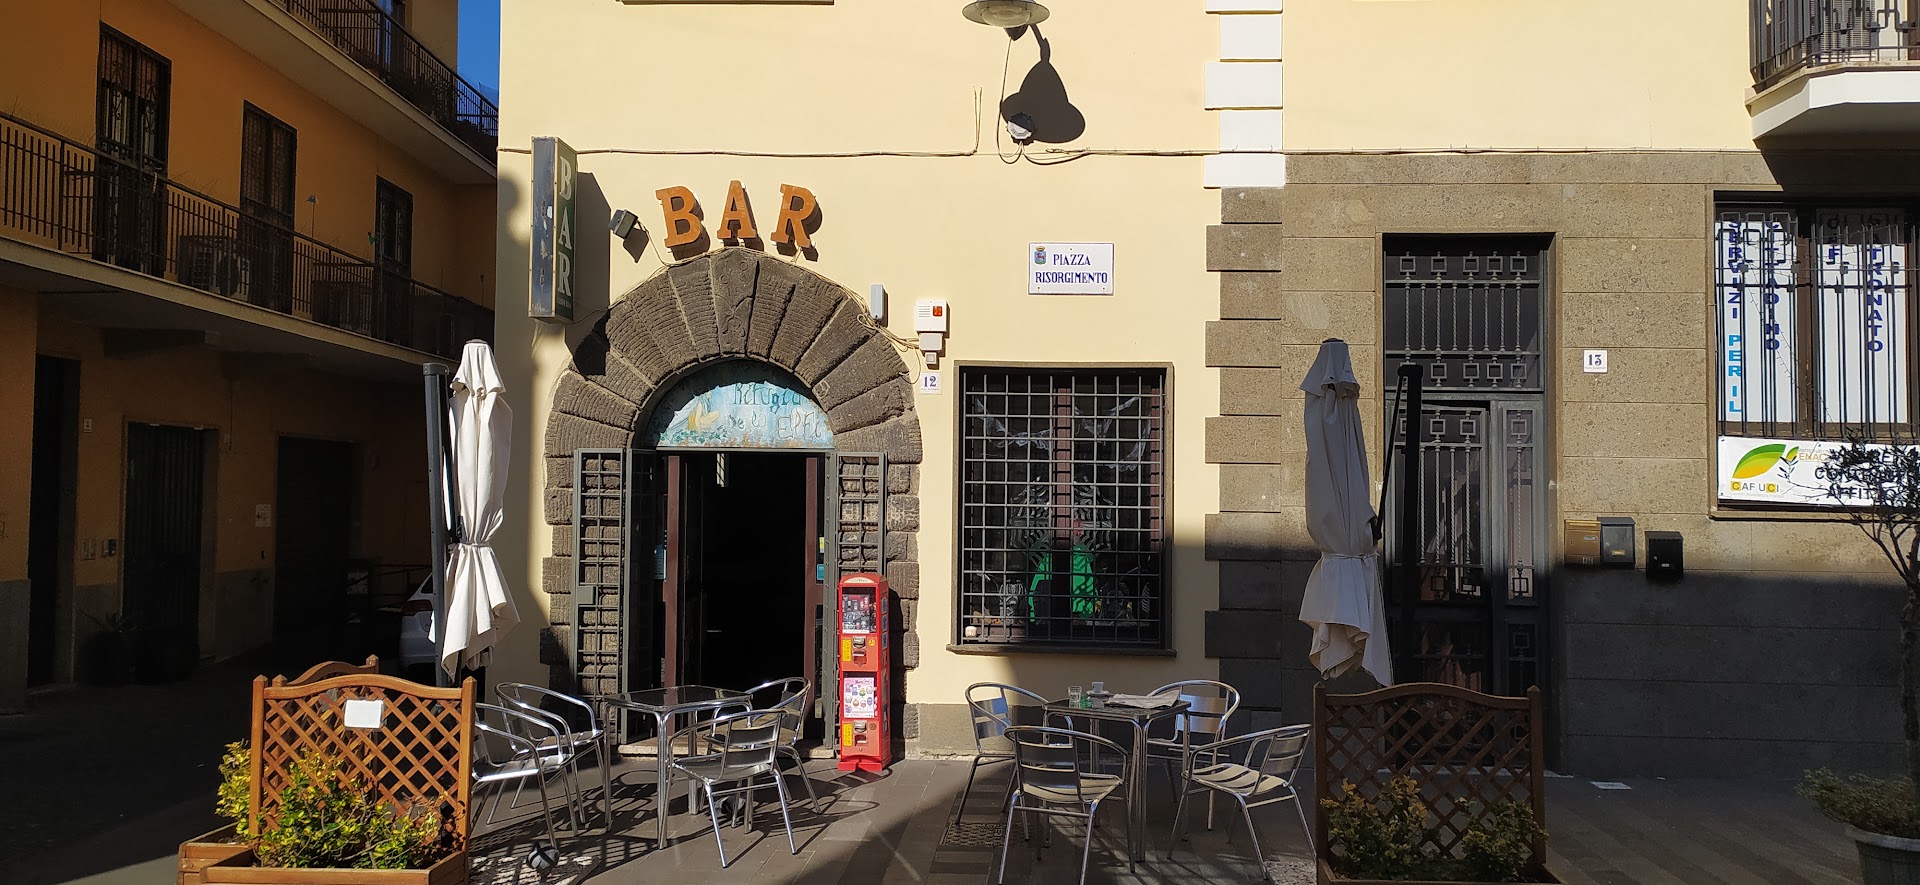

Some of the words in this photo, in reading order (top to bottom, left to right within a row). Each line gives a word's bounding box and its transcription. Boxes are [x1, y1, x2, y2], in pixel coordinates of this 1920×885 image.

[655, 180, 815, 249] BAR
[558, 156, 573, 297] BAR
[1052, 253, 1091, 266] PIAZZA
[1035, 271, 1108, 284] RISORGIMENTO
[1588, 354, 1602, 366] 13
[923, 375, 937, 388] 12
[1731, 481, 1756, 492] CAF
[1758, 483, 1780, 493] UCI
